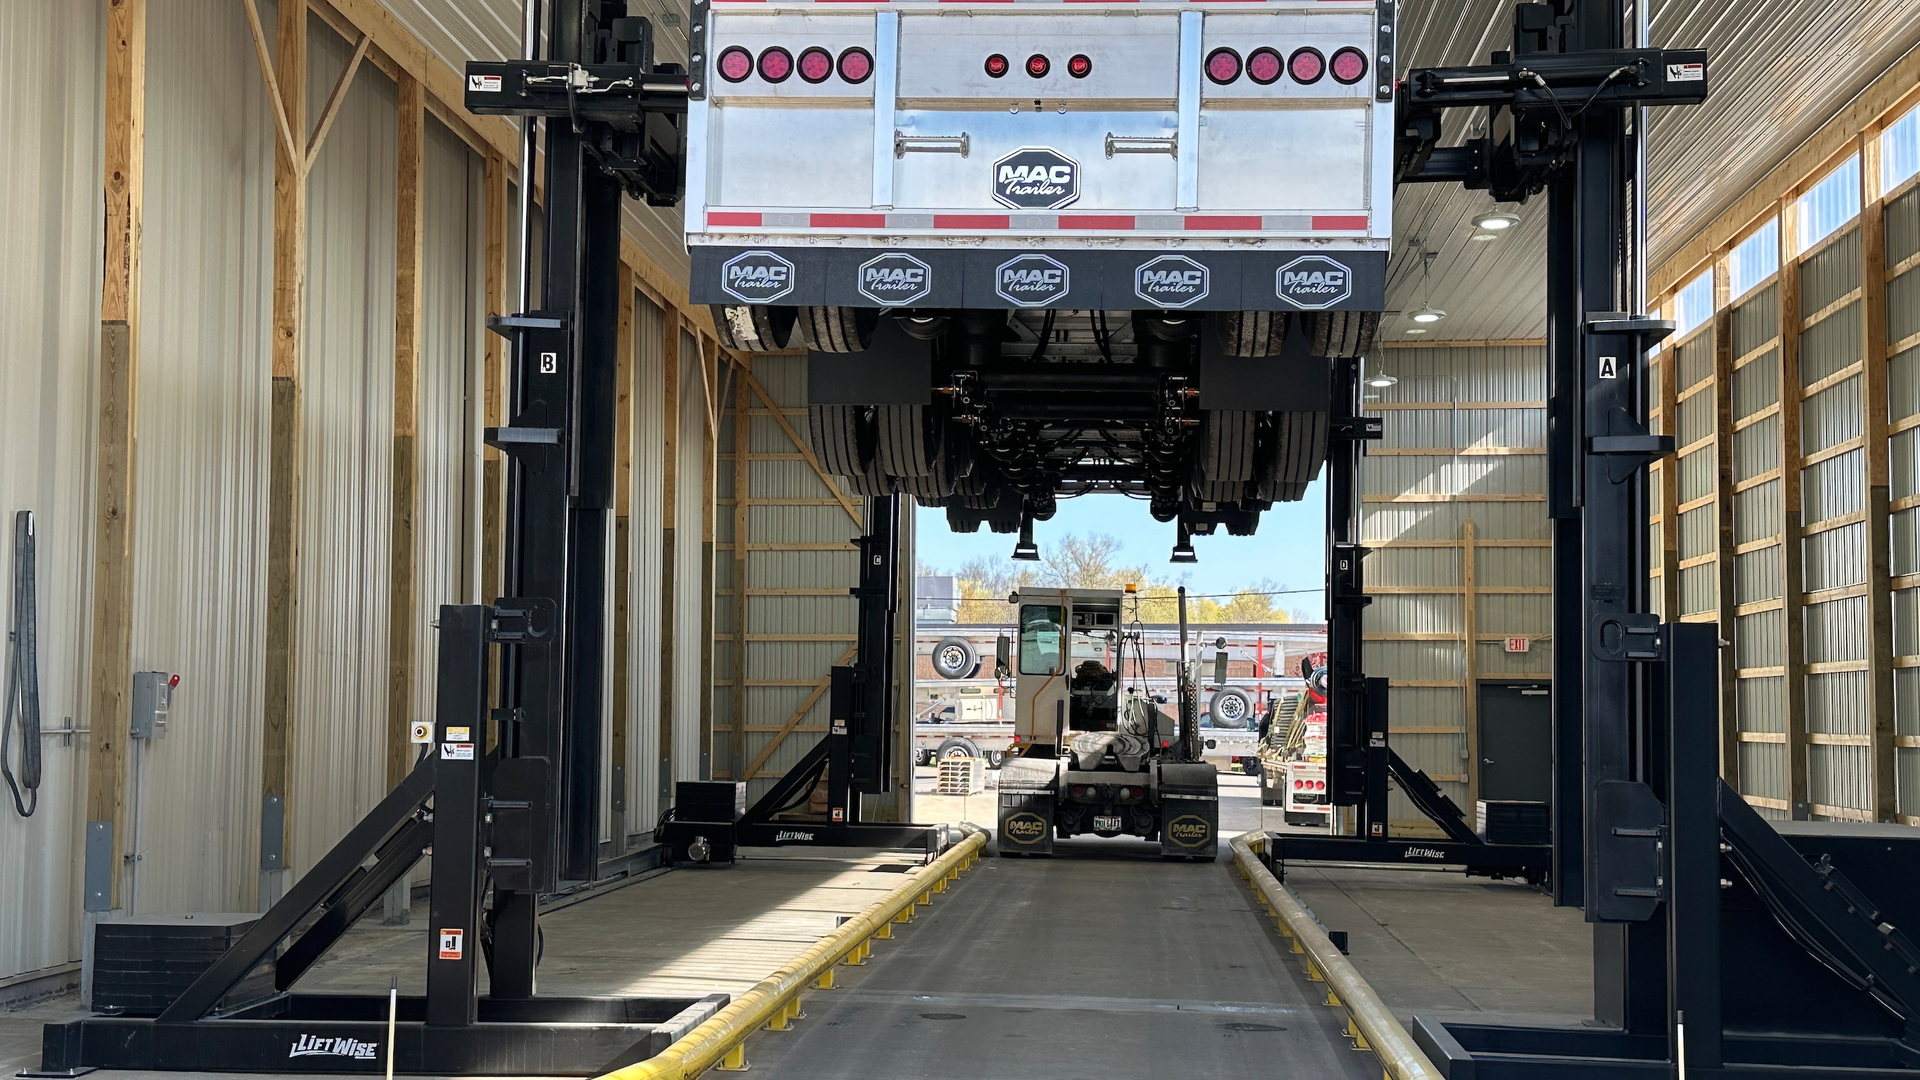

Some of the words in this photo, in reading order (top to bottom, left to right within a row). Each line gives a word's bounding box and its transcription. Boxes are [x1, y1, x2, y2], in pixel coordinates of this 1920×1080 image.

[999, 166, 1071, 183] MAC
[1004, 177, 1065, 194] Trailer
[730, 266, 787, 280] MAC
[866, 268, 923, 282] MAC
[1003, 270, 1061, 283] MAC
[1143, 271, 1201, 284] MAC
[1284, 272, 1343, 285] MAC
[734, 274, 781, 288] Trailer
[870, 277, 917, 290] Trailer
[1007, 278, 1055, 291] Trailer
[1147, 279, 1195, 292] Trailer
[1287, 281, 1338, 294] Trailer
[543, 354, 553, 371] B
[1601, 359, 1614, 376] A
[1509, 638, 1526, 651] EXIT
[1010, 821, 1042, 830] MAC
[1173, 824, 1206, 833] MAC
